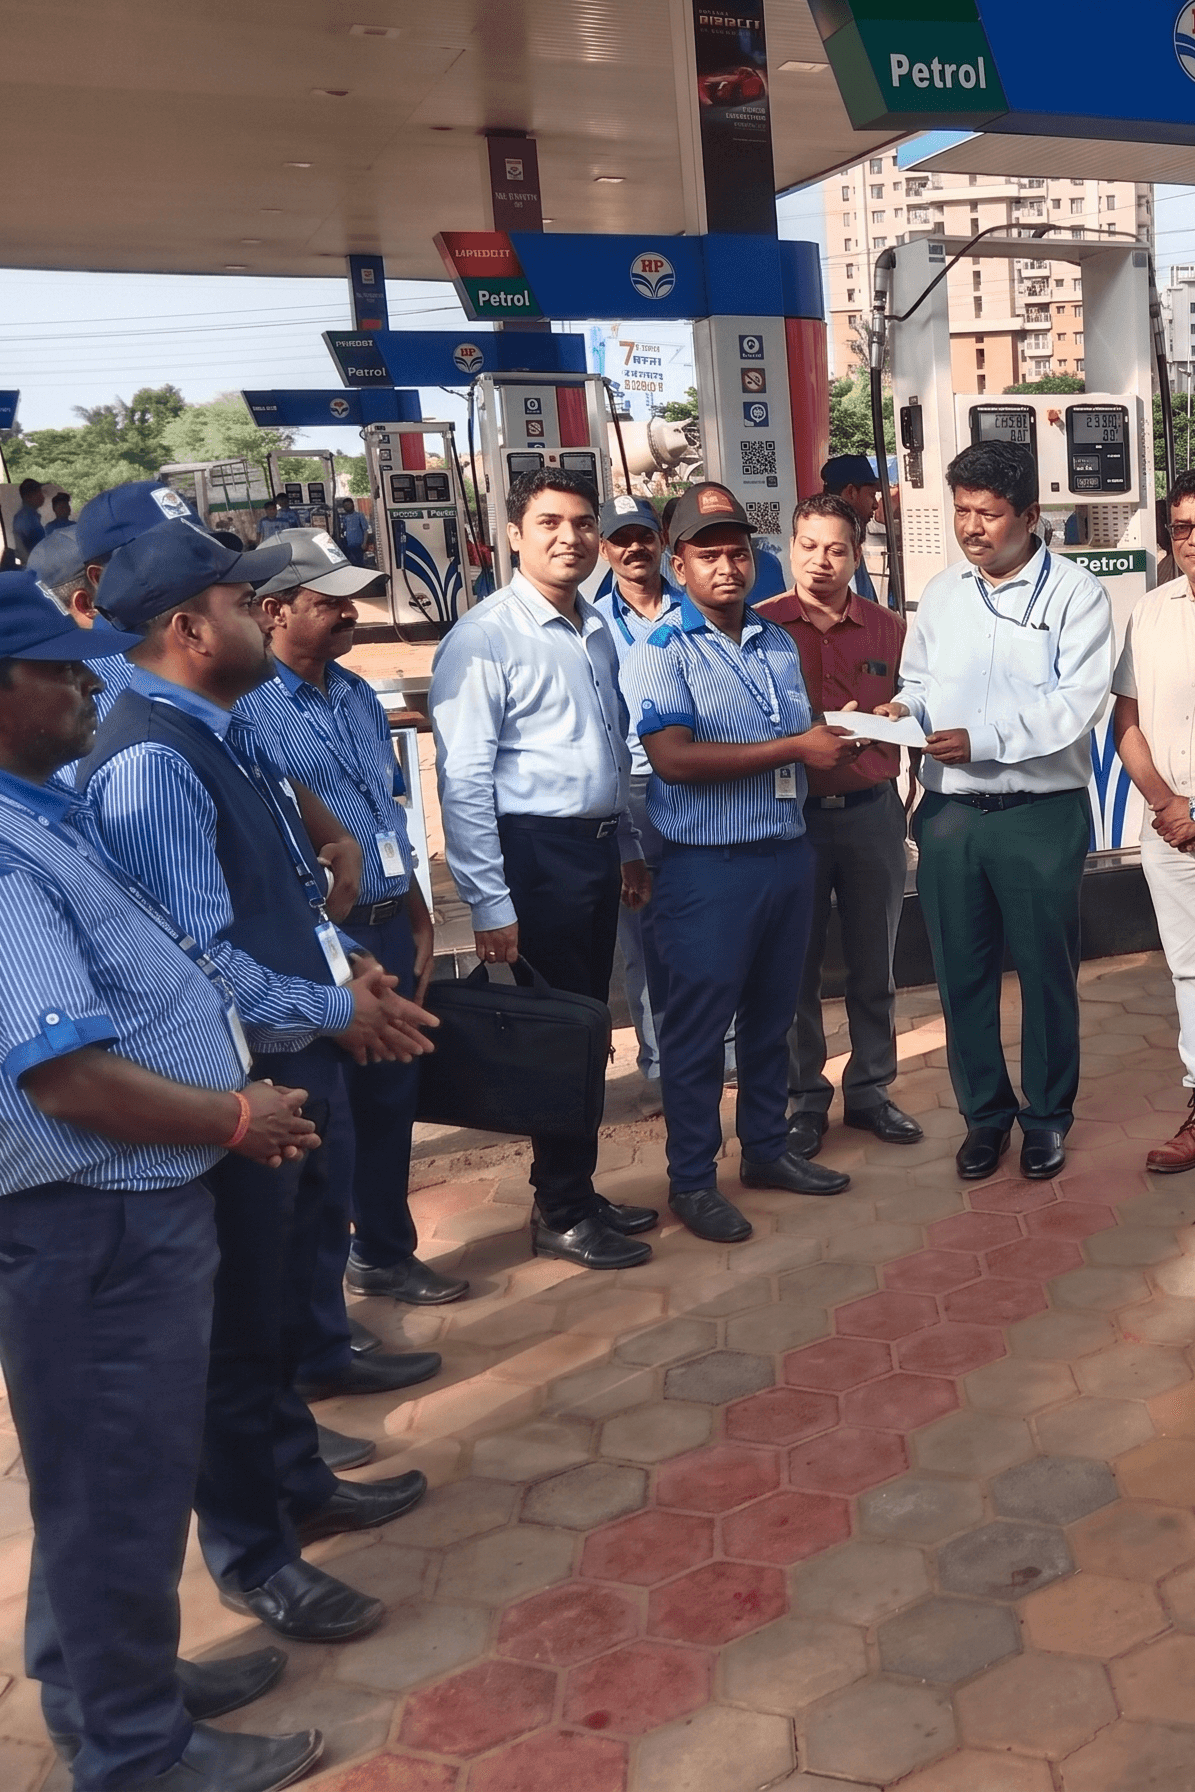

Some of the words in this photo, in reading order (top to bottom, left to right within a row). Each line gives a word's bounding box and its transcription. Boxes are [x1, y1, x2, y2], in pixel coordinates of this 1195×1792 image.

[889, 53, 987, 89] Petrol
[641, 259, 664, 272] HP
[478, 290, 530, 307] Petrol
[1076, 555, 1134, 572] Petrol
